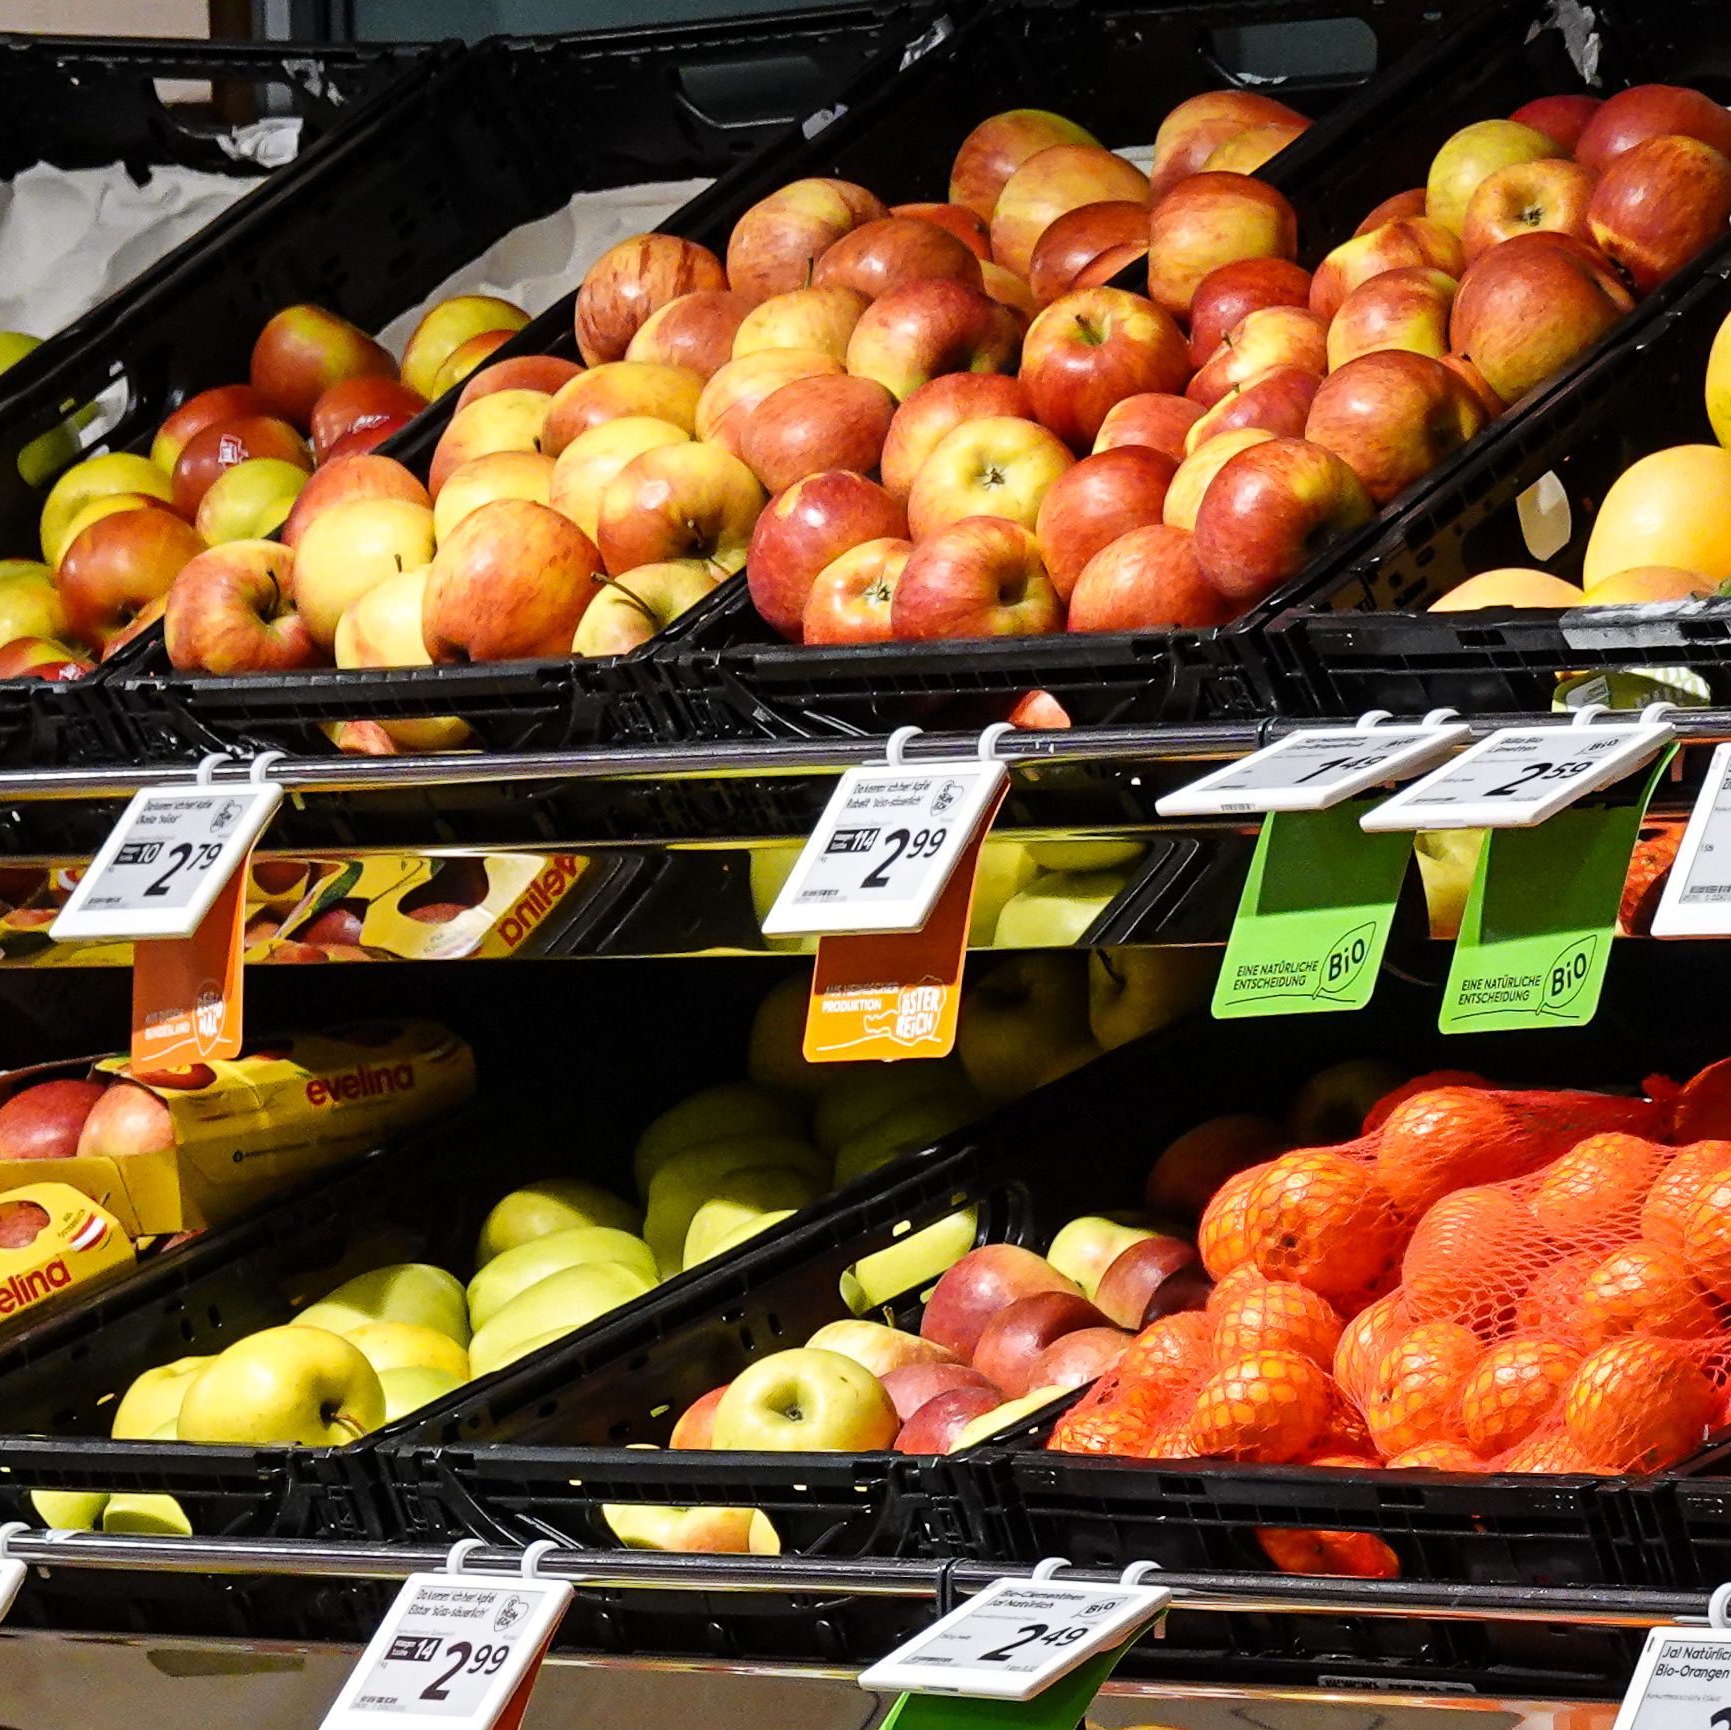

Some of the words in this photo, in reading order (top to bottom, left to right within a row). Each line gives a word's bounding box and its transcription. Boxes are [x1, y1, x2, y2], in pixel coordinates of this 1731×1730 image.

[1327, 938, 1365, 981] BiO
[1237, 964, 1259, 978] EINE
[1259, 960, 1319, 975] NATÜRLICHE
[1551, 953, 1587, 997] BiO
[1233, 974, 1307, 991] ENTSCHEIDUNG
[1461, 979, 1482, 992] EINE
[1483, 974, 1541, 991] NATÜRLICHE
[822, 999, 882, 1014] PRODUKTION
[1458, 989, 1530, 1006] ENTSCHEIDUNG
[306, 1063, 416, 1106] evelina
[1083, 1601, 1117, 1617] BiO
[1662, 1645, 1681, 1660] Ja!
[1655, 1663, 1731, 1682] Bio-Orangen
